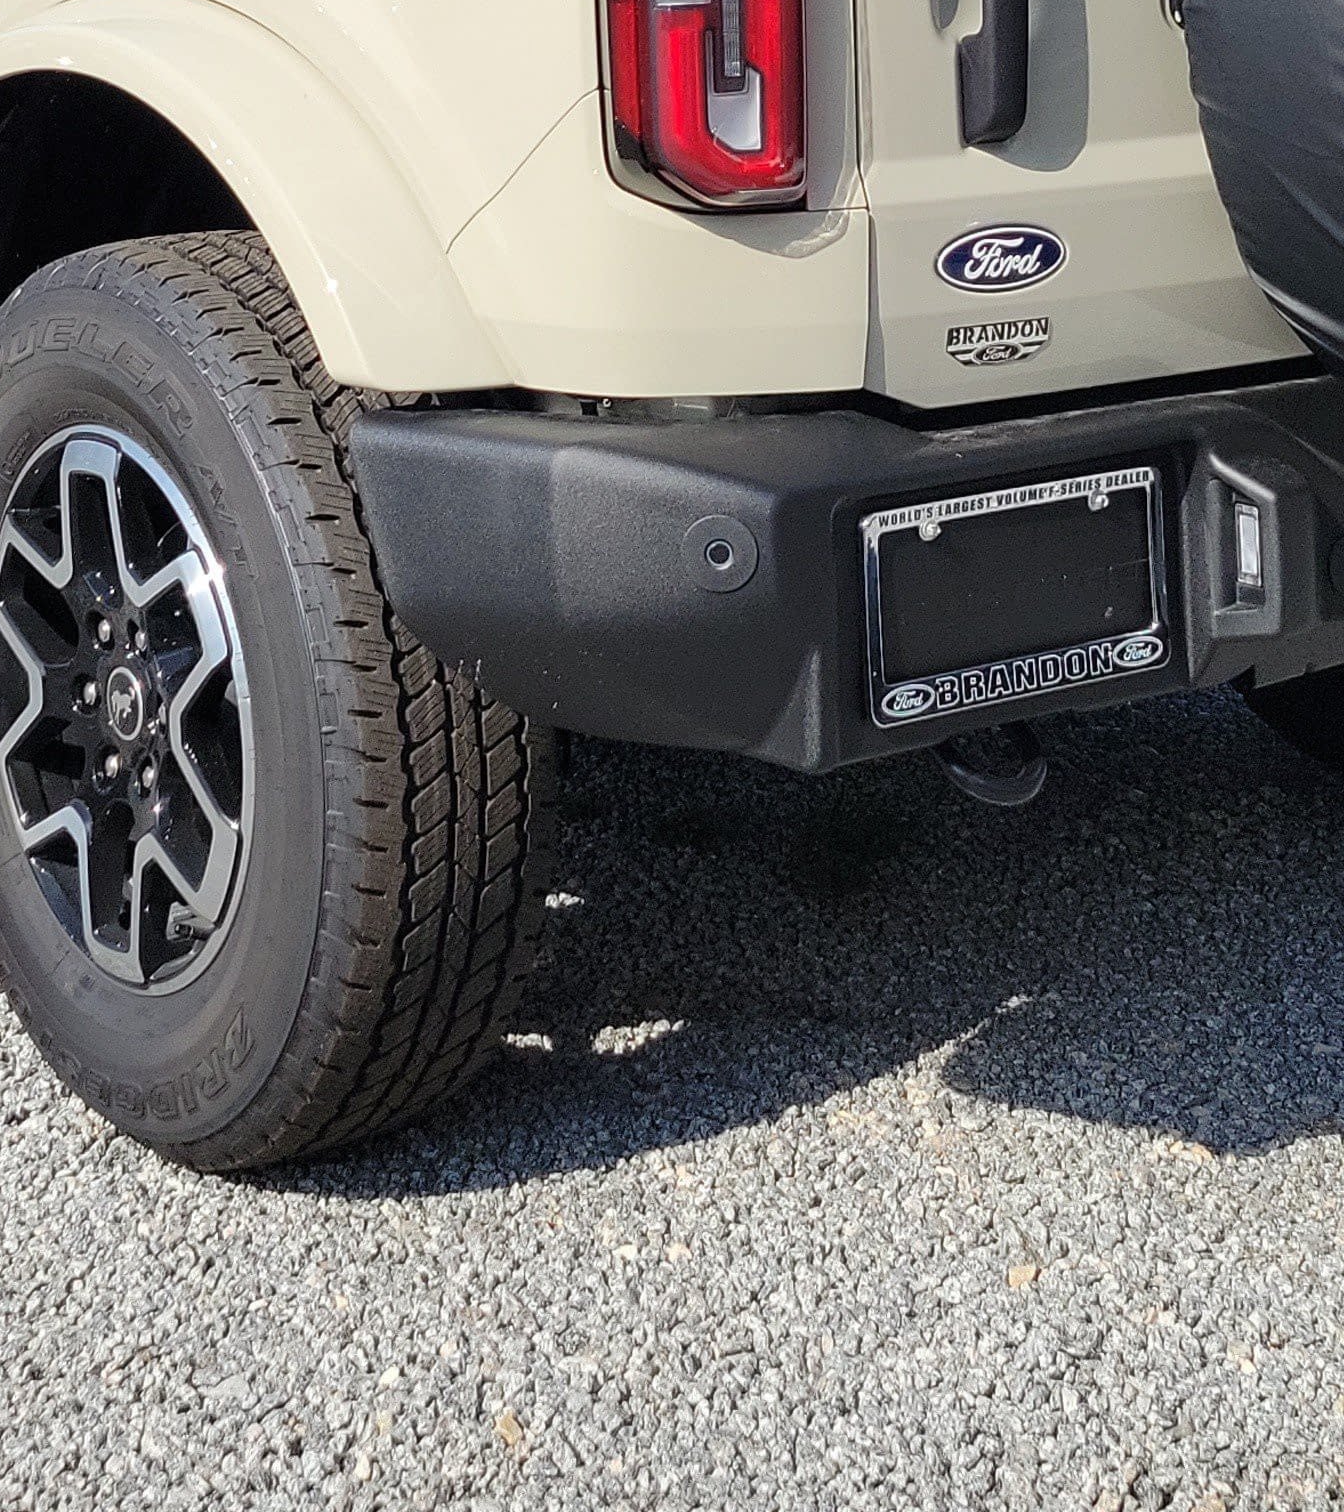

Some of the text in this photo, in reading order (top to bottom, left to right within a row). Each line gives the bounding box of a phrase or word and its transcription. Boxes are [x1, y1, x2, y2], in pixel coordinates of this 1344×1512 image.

[964, 237, 1043, 280] Ford
[947, 317, 1050, 346] BRANDON
[982, 346, 1012, 360] Ford
[878, 470, 1150, 528] WORLD'S LARGEST VOLUME F-SERIES DEALER
[893, 642, 1152, 710] Ford BRANDON Ford
